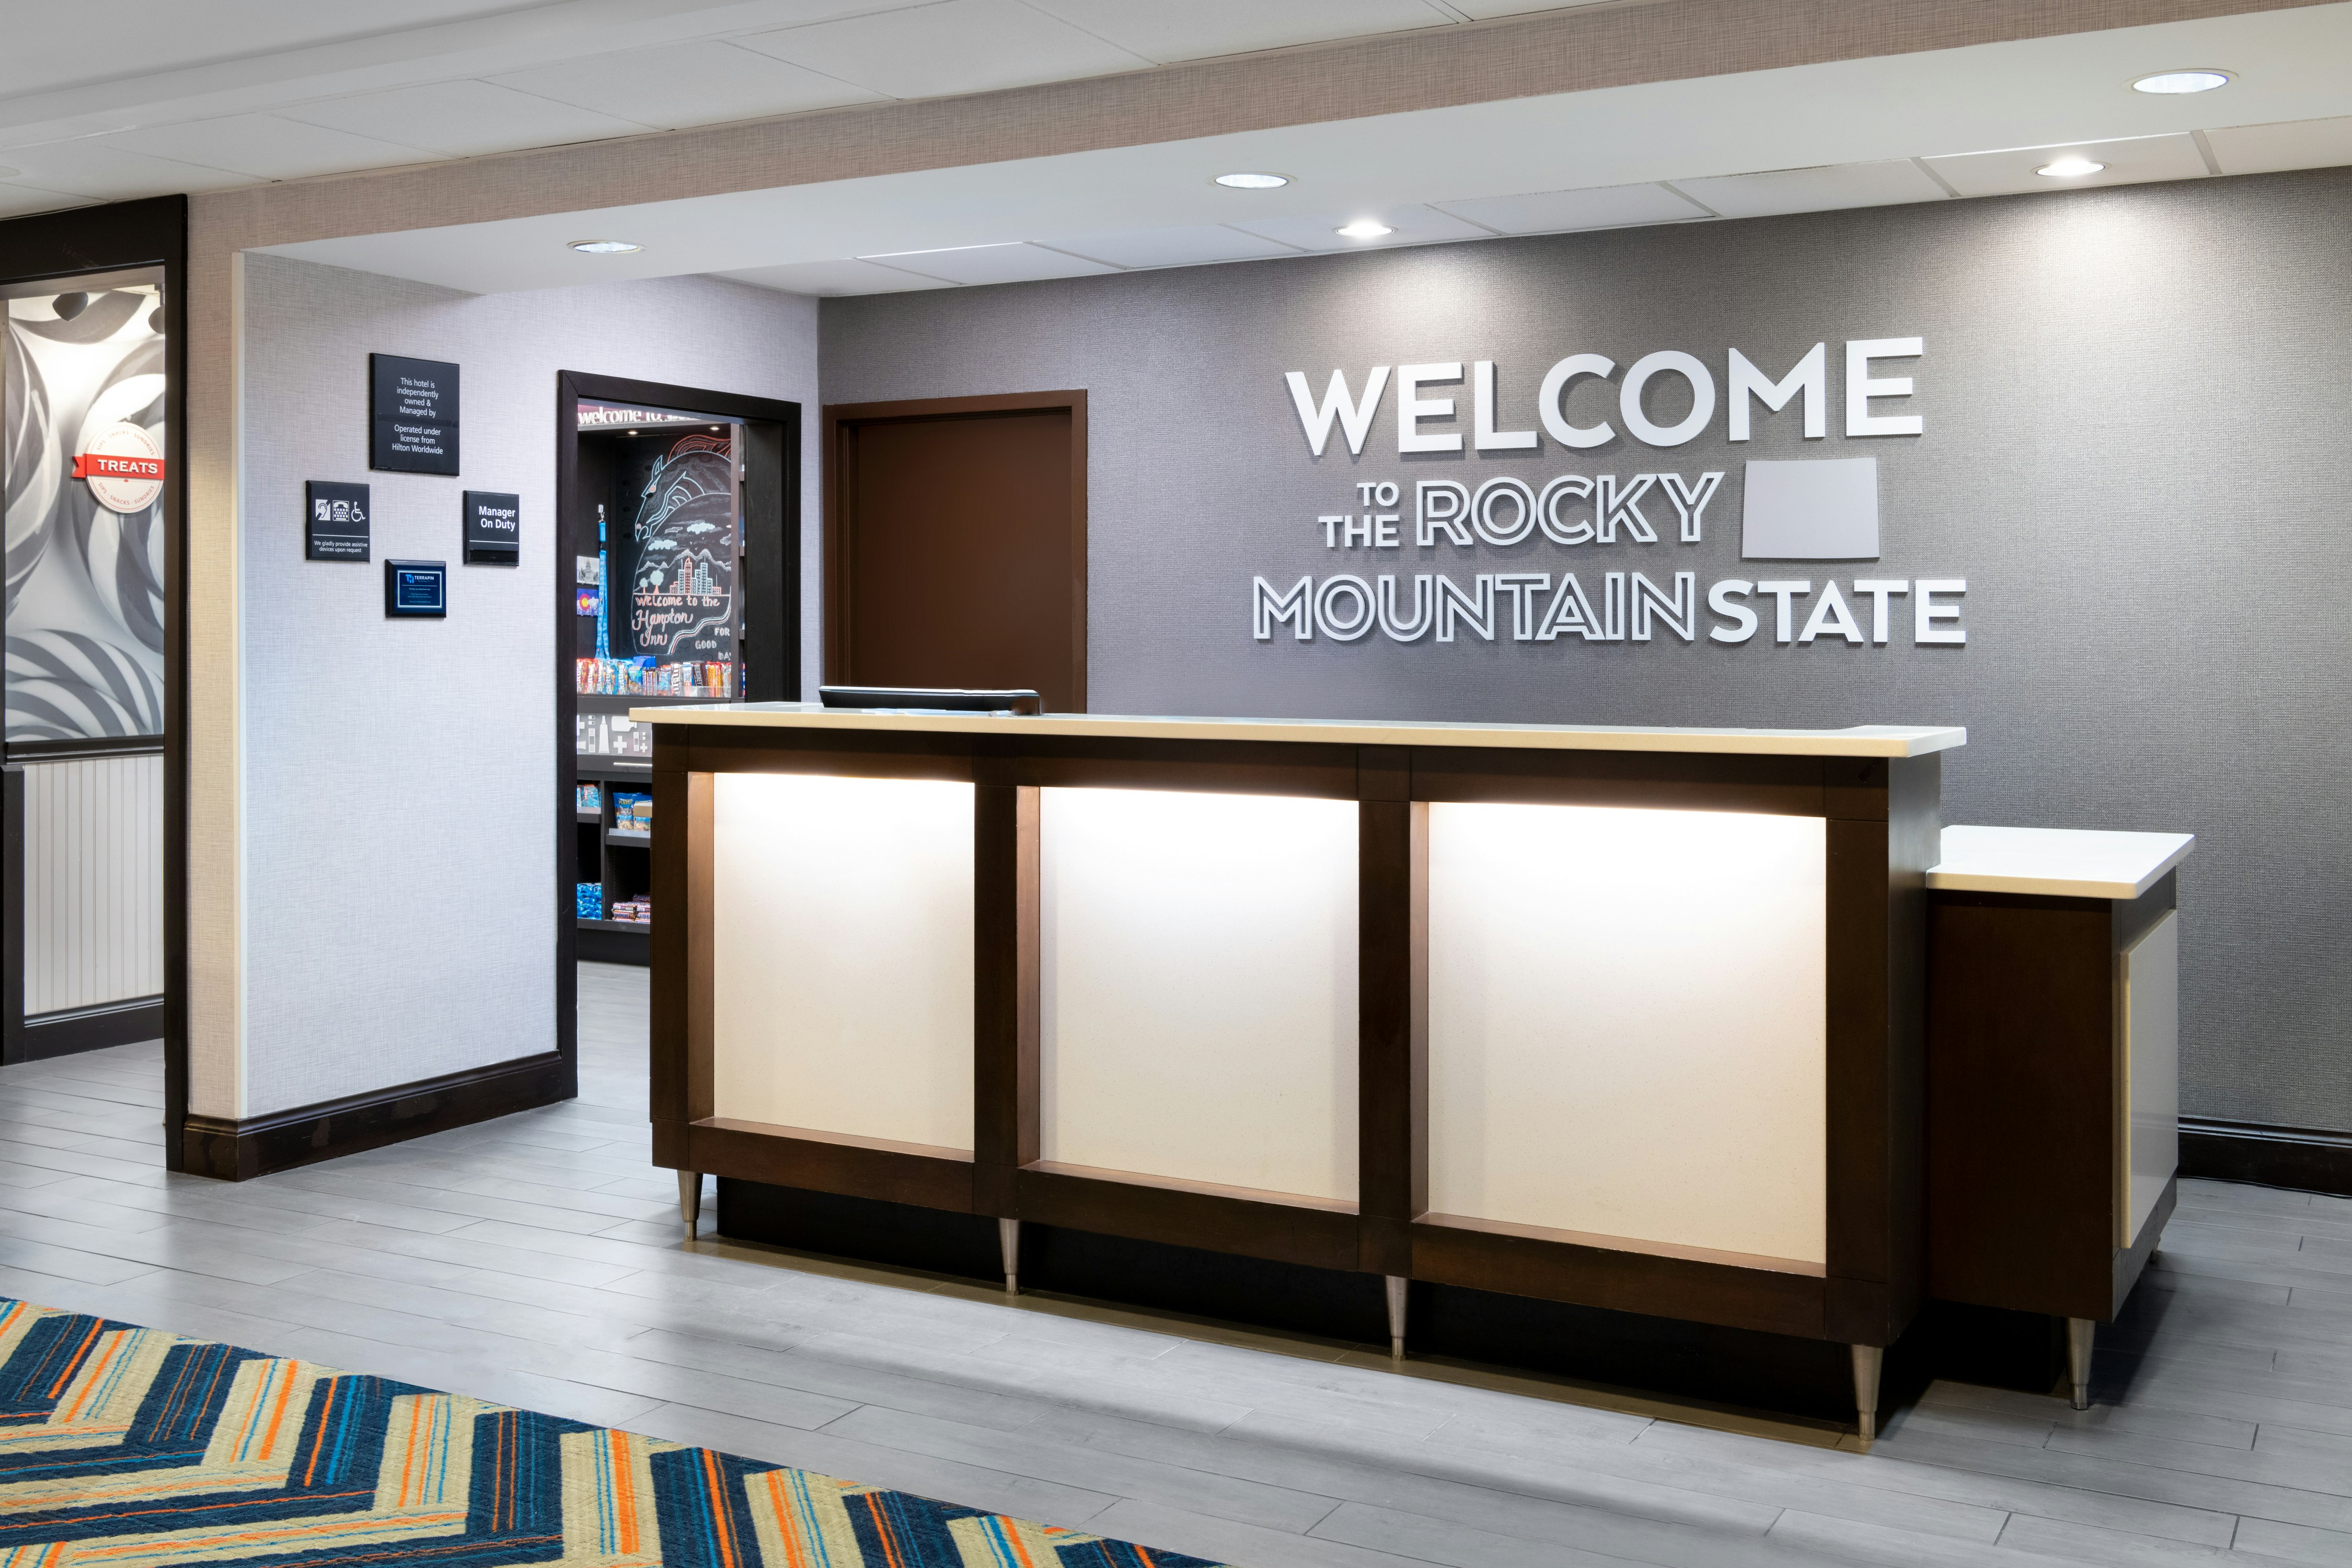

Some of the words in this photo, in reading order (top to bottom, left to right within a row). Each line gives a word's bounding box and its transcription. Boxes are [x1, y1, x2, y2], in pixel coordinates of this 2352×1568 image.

[400, 377, 412, 386] This
[414, 379, 429, 388] hotel
[397, 387, 439, 400] independently
[1285, 337, 1923, 456] WELCOME
[399, 406, 428, 417] Managed
[429, 409, 436, 418] by
[578, 407, 641, 424] welcome
[394, 424, 422, 433] Operated
[97, 440, 106, 451] SIPS
[134, 433, 155, 455] SUNDRIES
[400, 434, 420, 443] license
[421, 436, 435, 444] from
[392, 443, 410, 452] Hilton
[411, 445, 443, 454] Worldwide
[97, 459, 158, 474] TREATS
[98, 482, 107, 494] SIPS
[110, 495, 130, 505] SNACKS
[134, 486, 155, 504] SUNDRIES
[1357, 482, 1400, 506] TO
[479, 505, 516, 519] Manager
[1416, 471, 1725, 546] ROCKY
[481, 518, 493, 528] On
[495, 519, 515, 532] Duty
[1318, 514, 1400, 547] THE
[636, 595, 683, 607] welcome
[686, 595, 698, 606] to
[701, 596, 720, 606] the
[1254, 572, 1695, 642] MOUNTAIN
[1708, 579, 1966, 643] STATE
[632, 608, 694, 632] Hampton
[640, 626, 667, 647] Inn
[714, 627, 730, 636] FOR
[695, 640, 717, 650] GOOD
[718, 651, 731, 661] DA
